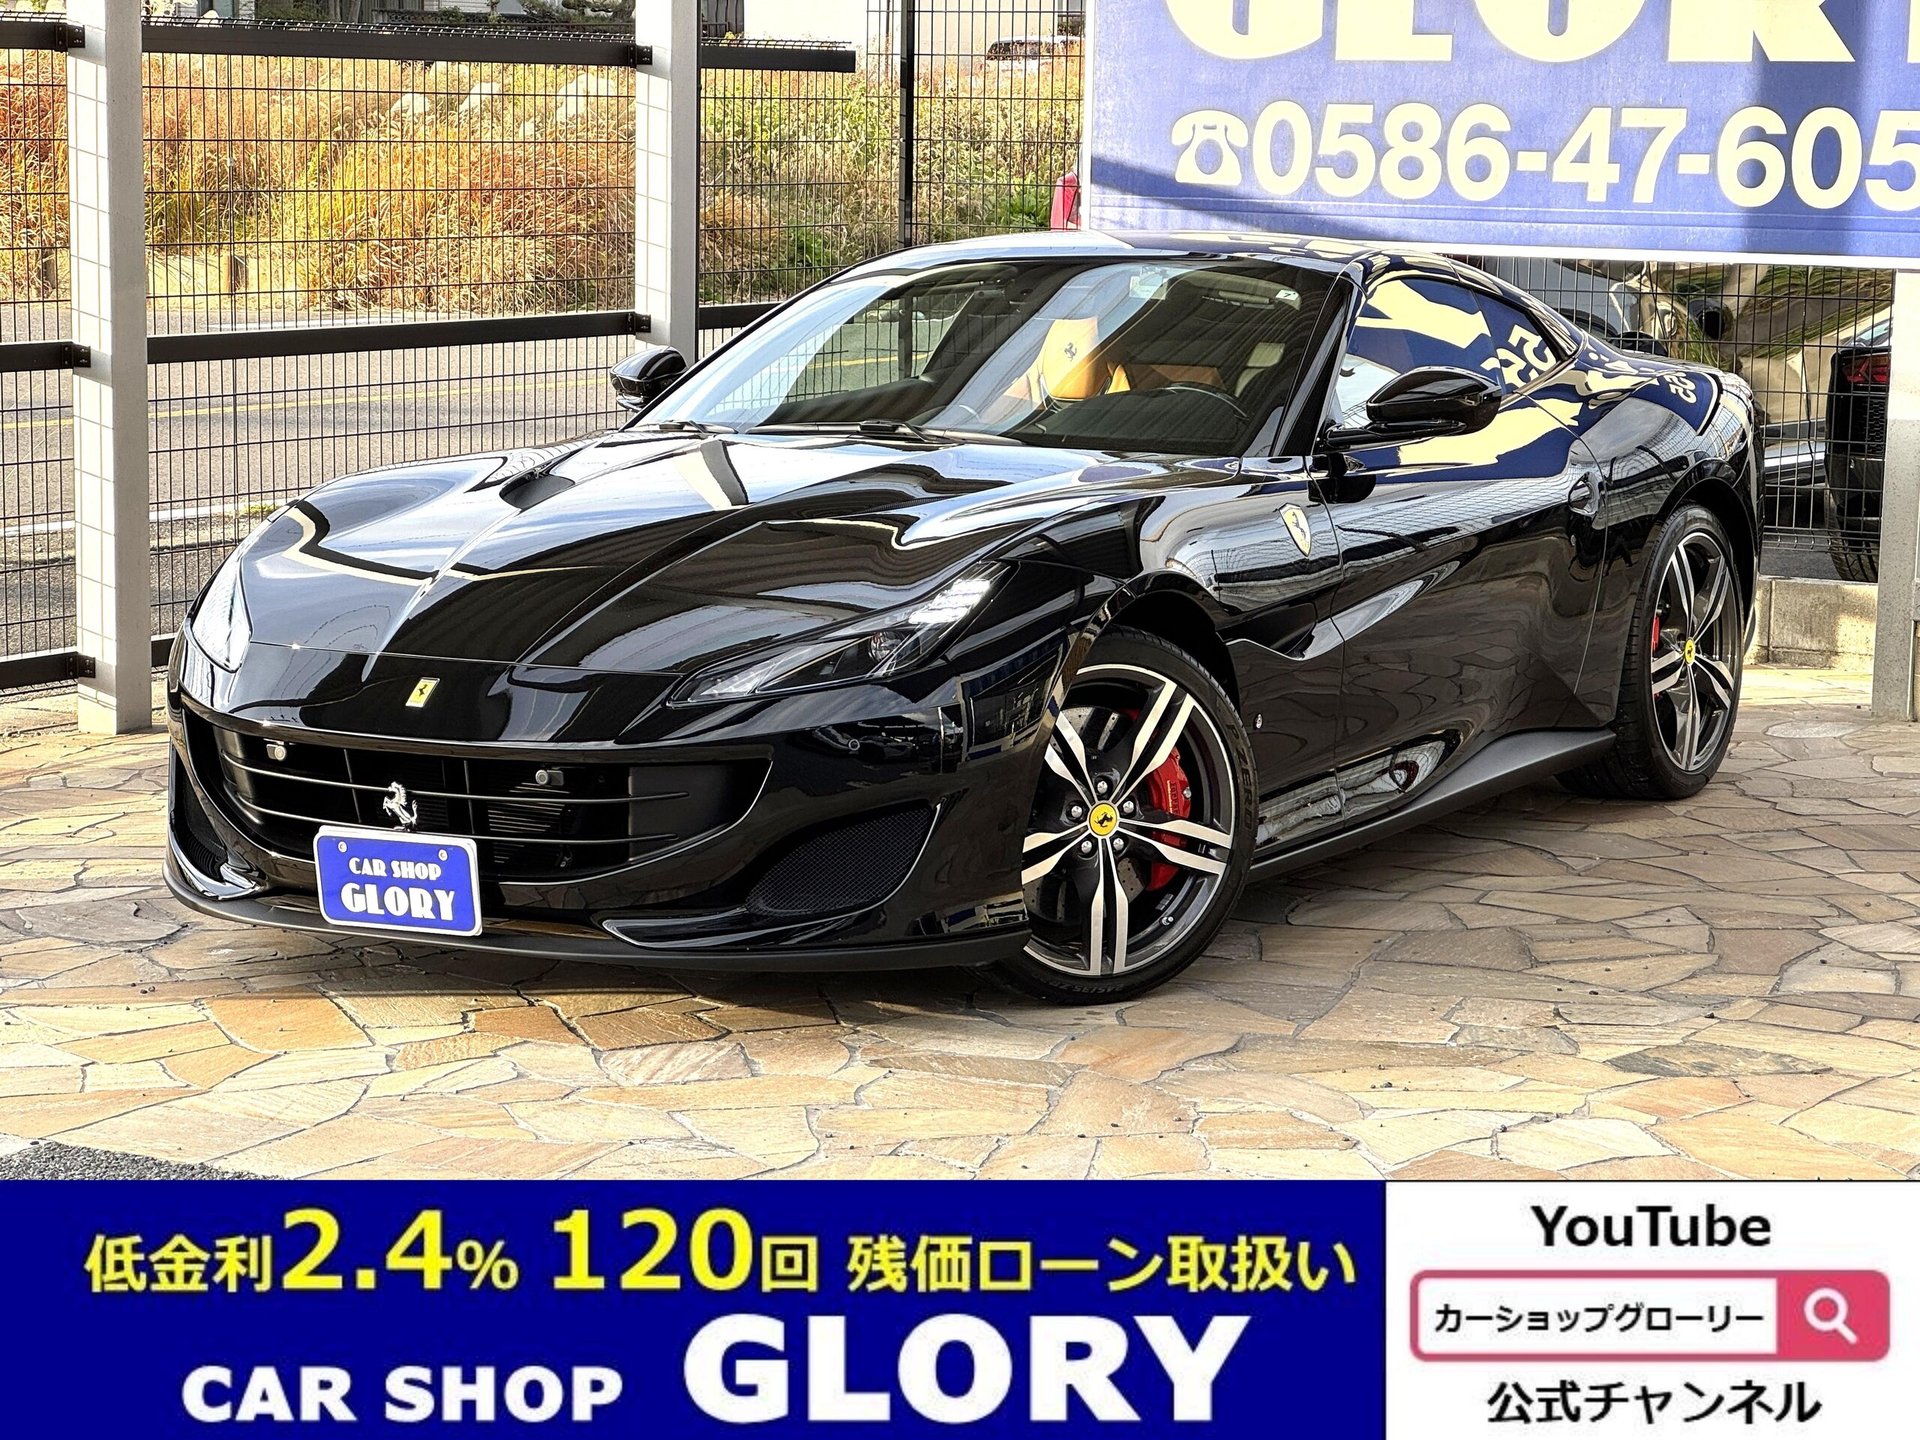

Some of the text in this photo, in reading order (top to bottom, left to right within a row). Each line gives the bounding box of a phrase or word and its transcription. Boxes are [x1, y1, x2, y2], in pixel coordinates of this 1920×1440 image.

[349, 858, 441, 880] CAR SHOP
[341, 883, 455, 921] GLORY
